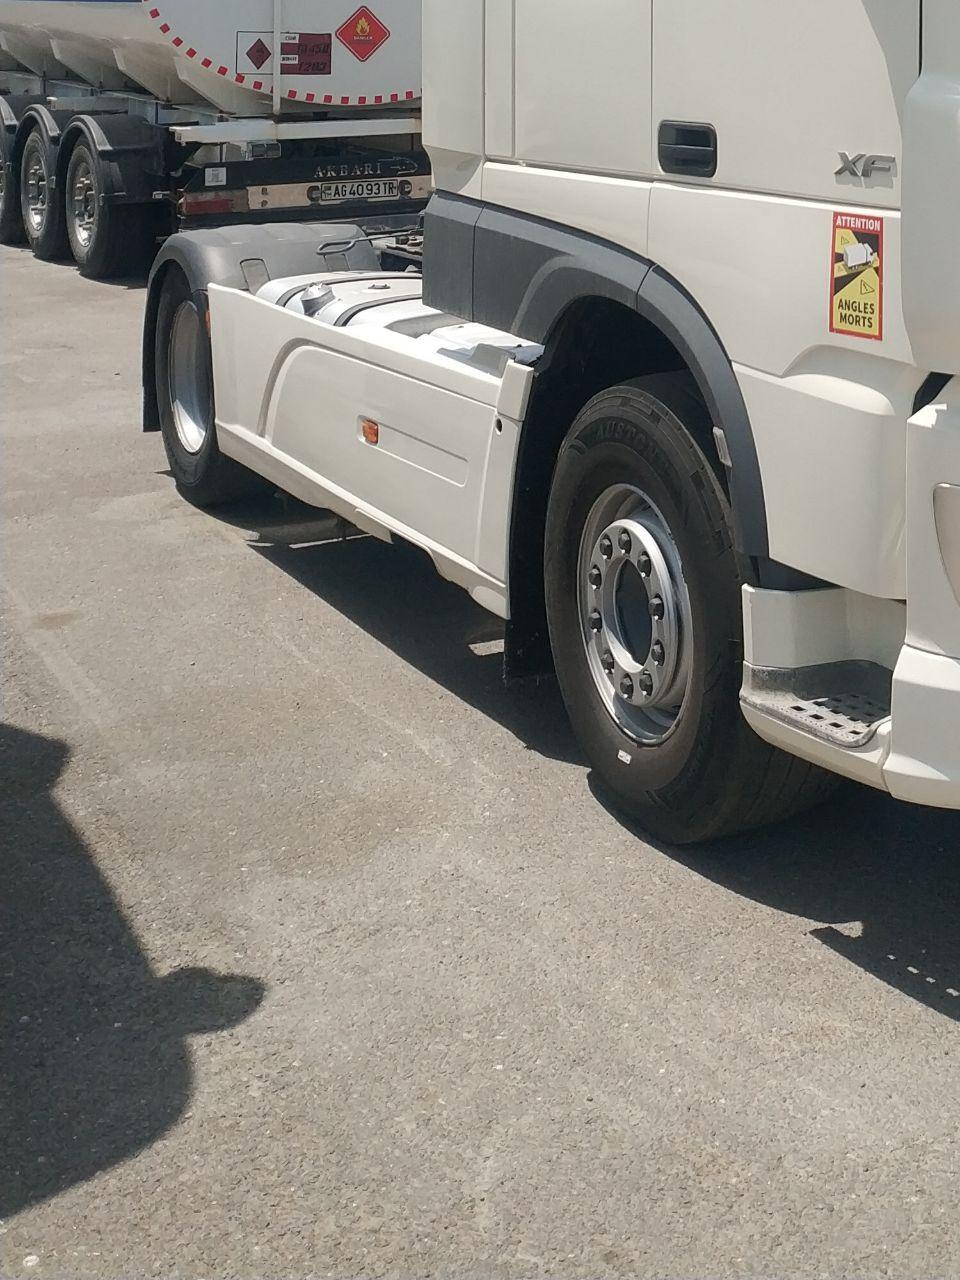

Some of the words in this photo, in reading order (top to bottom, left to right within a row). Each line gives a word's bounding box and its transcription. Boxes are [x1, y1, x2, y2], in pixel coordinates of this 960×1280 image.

[834, 151, 896, 178] XF
[836, 215, 881, 231] ATTENTION
[837, 298, 875, 315] ANGLES
[839, 313, 873, 329] MORTS
